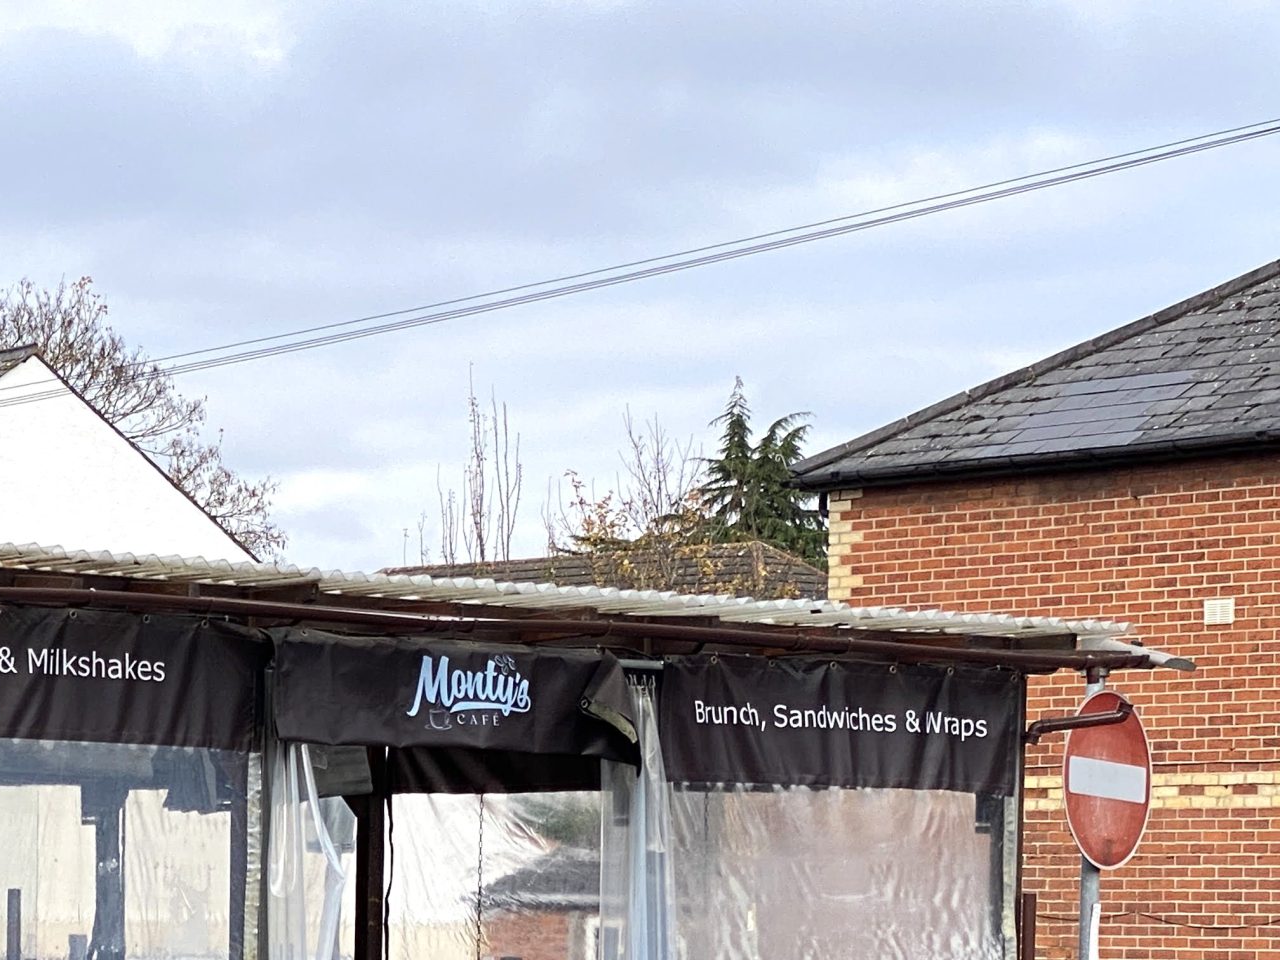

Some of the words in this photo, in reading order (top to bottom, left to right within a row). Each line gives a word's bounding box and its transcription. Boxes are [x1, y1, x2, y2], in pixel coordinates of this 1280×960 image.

[27, 648, 166, 682] Milkshakes
[406, 655, 531, 717] Monty's
[457, 712, 500, 727] CAFÉ
[695, 700, 766, 732] Brunch,
[773, 704, 897, 733] Sandwiches
[905, 709, 921, 733] &
[925, 711, 988, 741] Wraps
